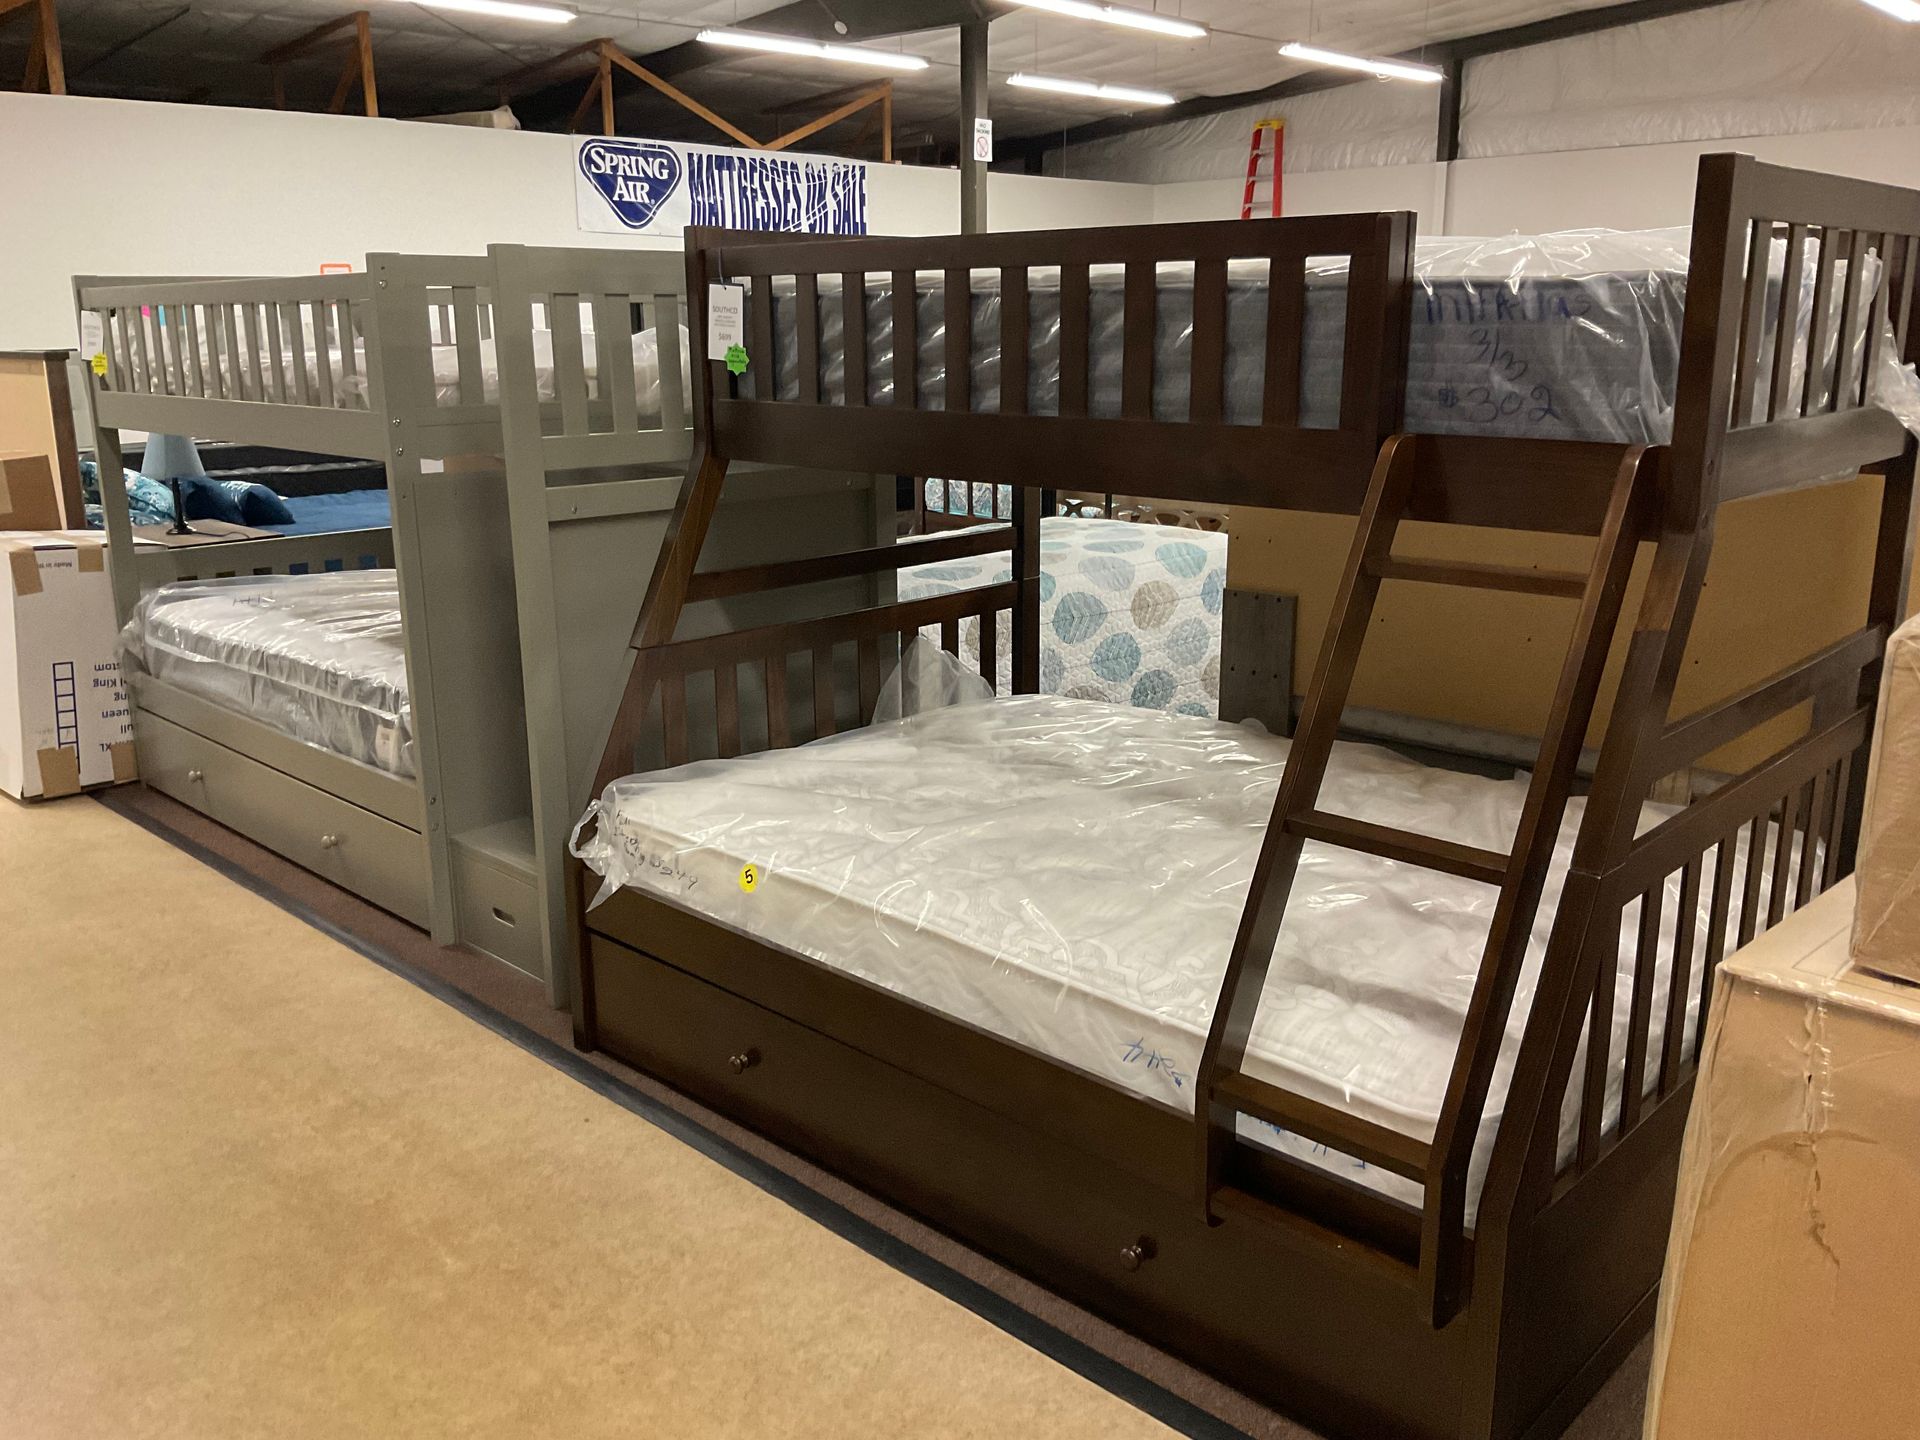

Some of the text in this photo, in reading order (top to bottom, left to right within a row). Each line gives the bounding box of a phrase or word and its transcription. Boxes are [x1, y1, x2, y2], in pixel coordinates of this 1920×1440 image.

[590, 147, 669, 180] SPRING
[612, 176, 650, 204] AIR
[687, 152, 867, 235] MATTRESSES ON SALE
[101, 708, 129, 718] ueen
[120, 723, 133, 734] ull
[745, 868, 754, 884] 5
